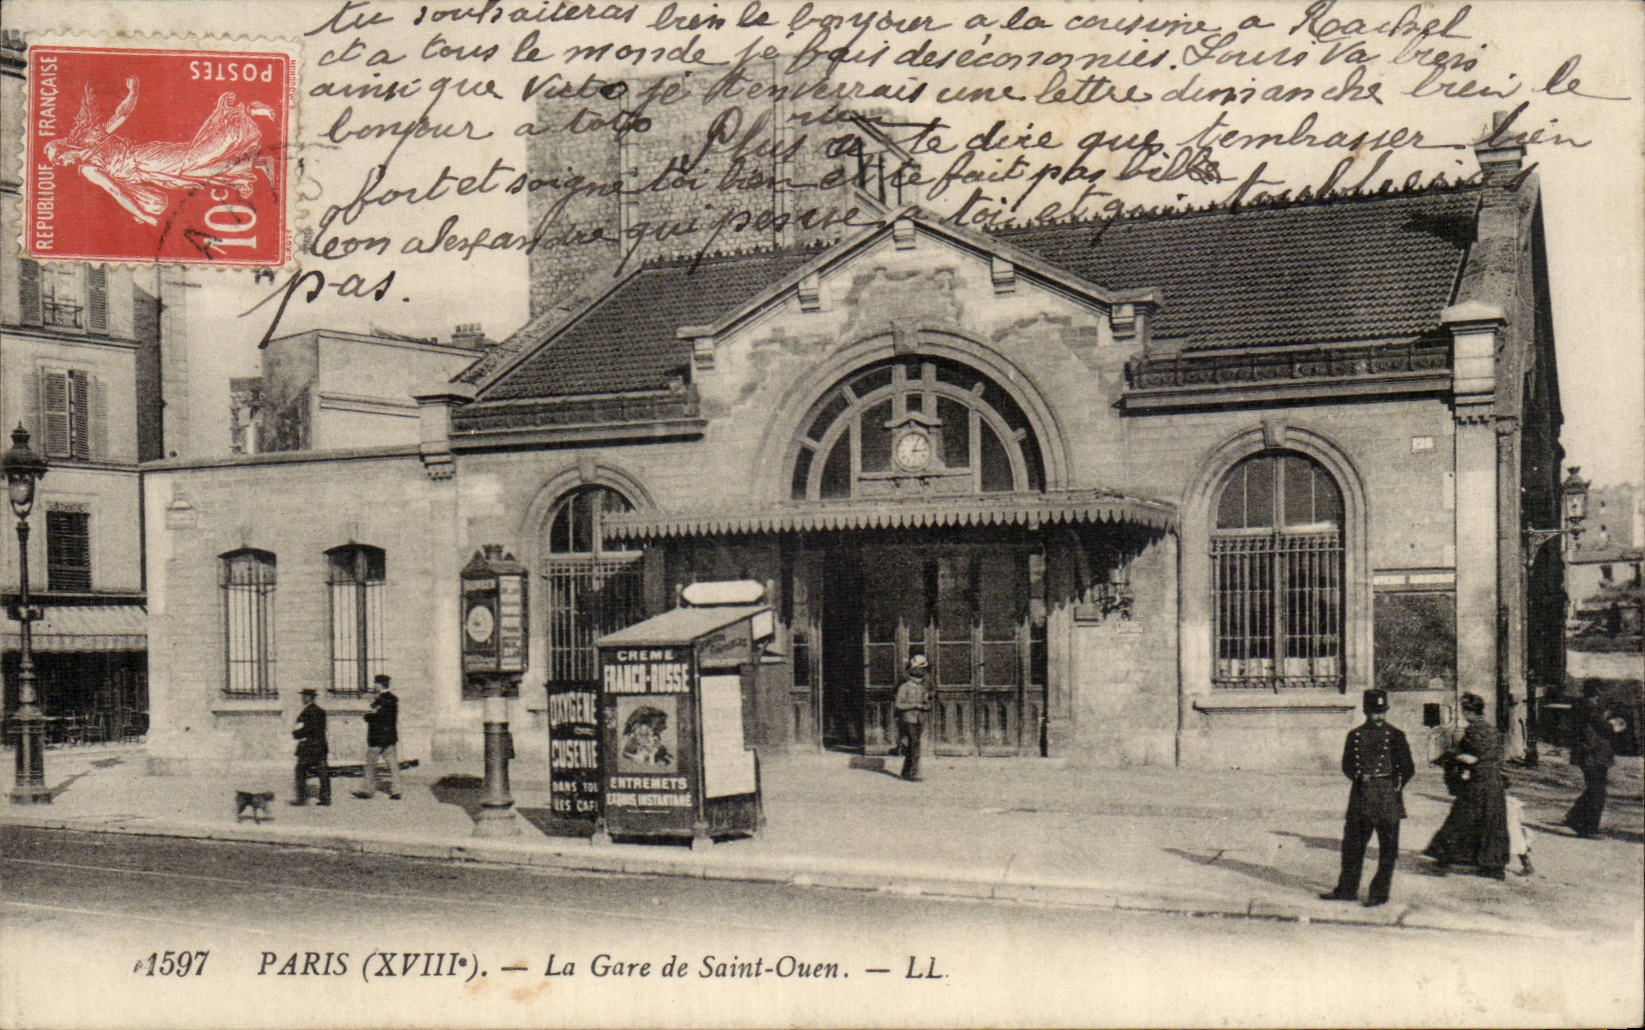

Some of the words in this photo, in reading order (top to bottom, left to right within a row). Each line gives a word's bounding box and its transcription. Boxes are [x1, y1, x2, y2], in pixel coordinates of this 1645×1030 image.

[736, 1, 779, 28] le
[1000, 6, 1053, 30] la
[511, 30, 553, 63] le
[190, 61, 273, 82] POSTES
[37, 56, 58, 137] FRANÇAISE
[609, 776, 688, 790] ENTREMETS
